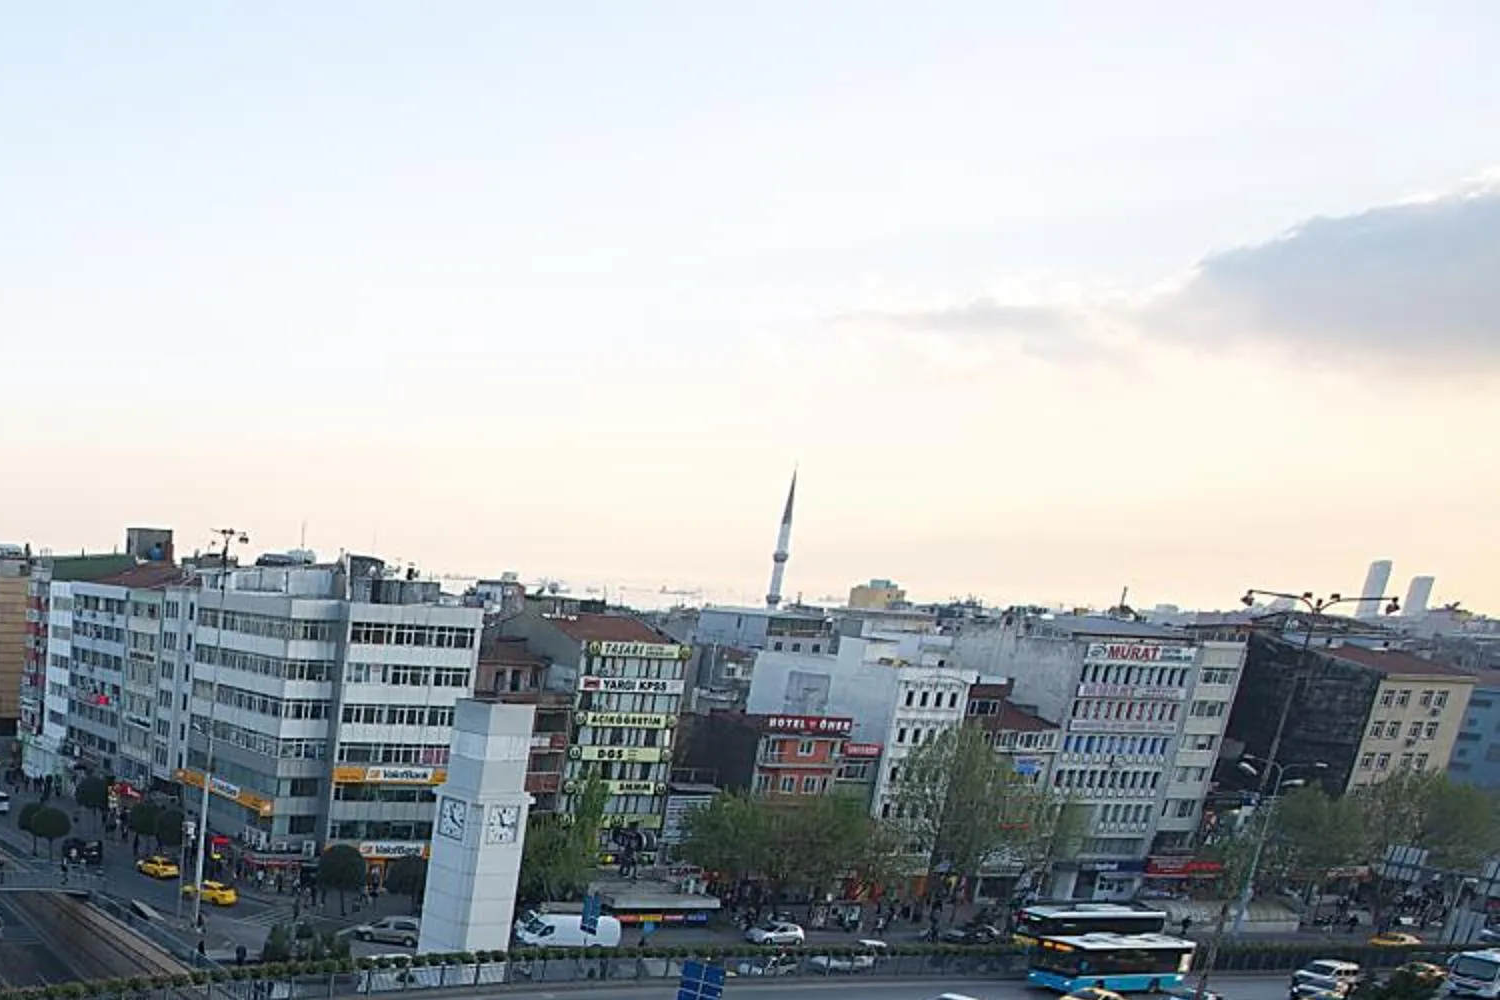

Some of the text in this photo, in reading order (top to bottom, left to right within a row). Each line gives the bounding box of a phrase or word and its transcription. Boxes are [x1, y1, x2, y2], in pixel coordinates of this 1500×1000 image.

[1108, 643, 1160, 662] MURAT
[639, 680, 667, 692] KPSS
[768, 717, 851, 732] HOTEL ÖNER
[597, 749, 624, 759] DGS
